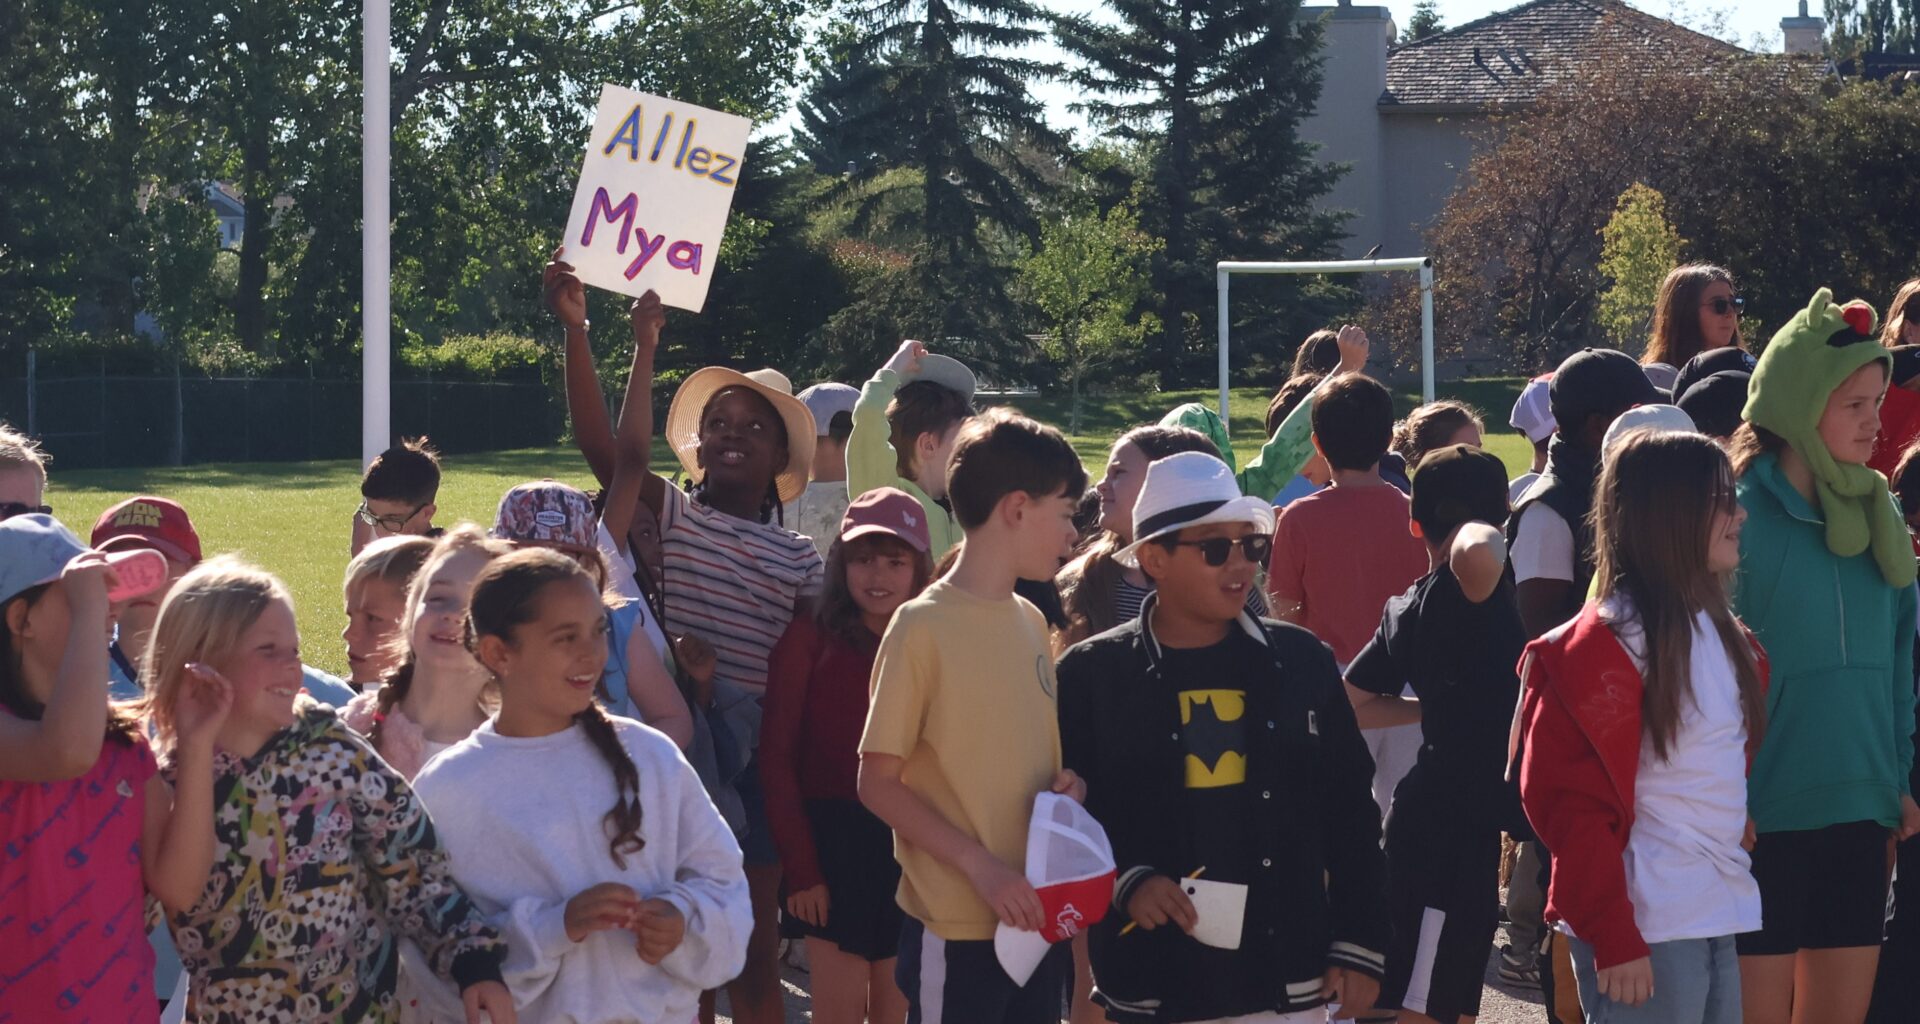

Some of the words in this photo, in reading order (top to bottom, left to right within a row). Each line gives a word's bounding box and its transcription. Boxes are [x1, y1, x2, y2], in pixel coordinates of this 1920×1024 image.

[602, 103, 738, 188] Allez
[580, 186, 703, 282] Mya
[116, 502, 163, 518] ON
